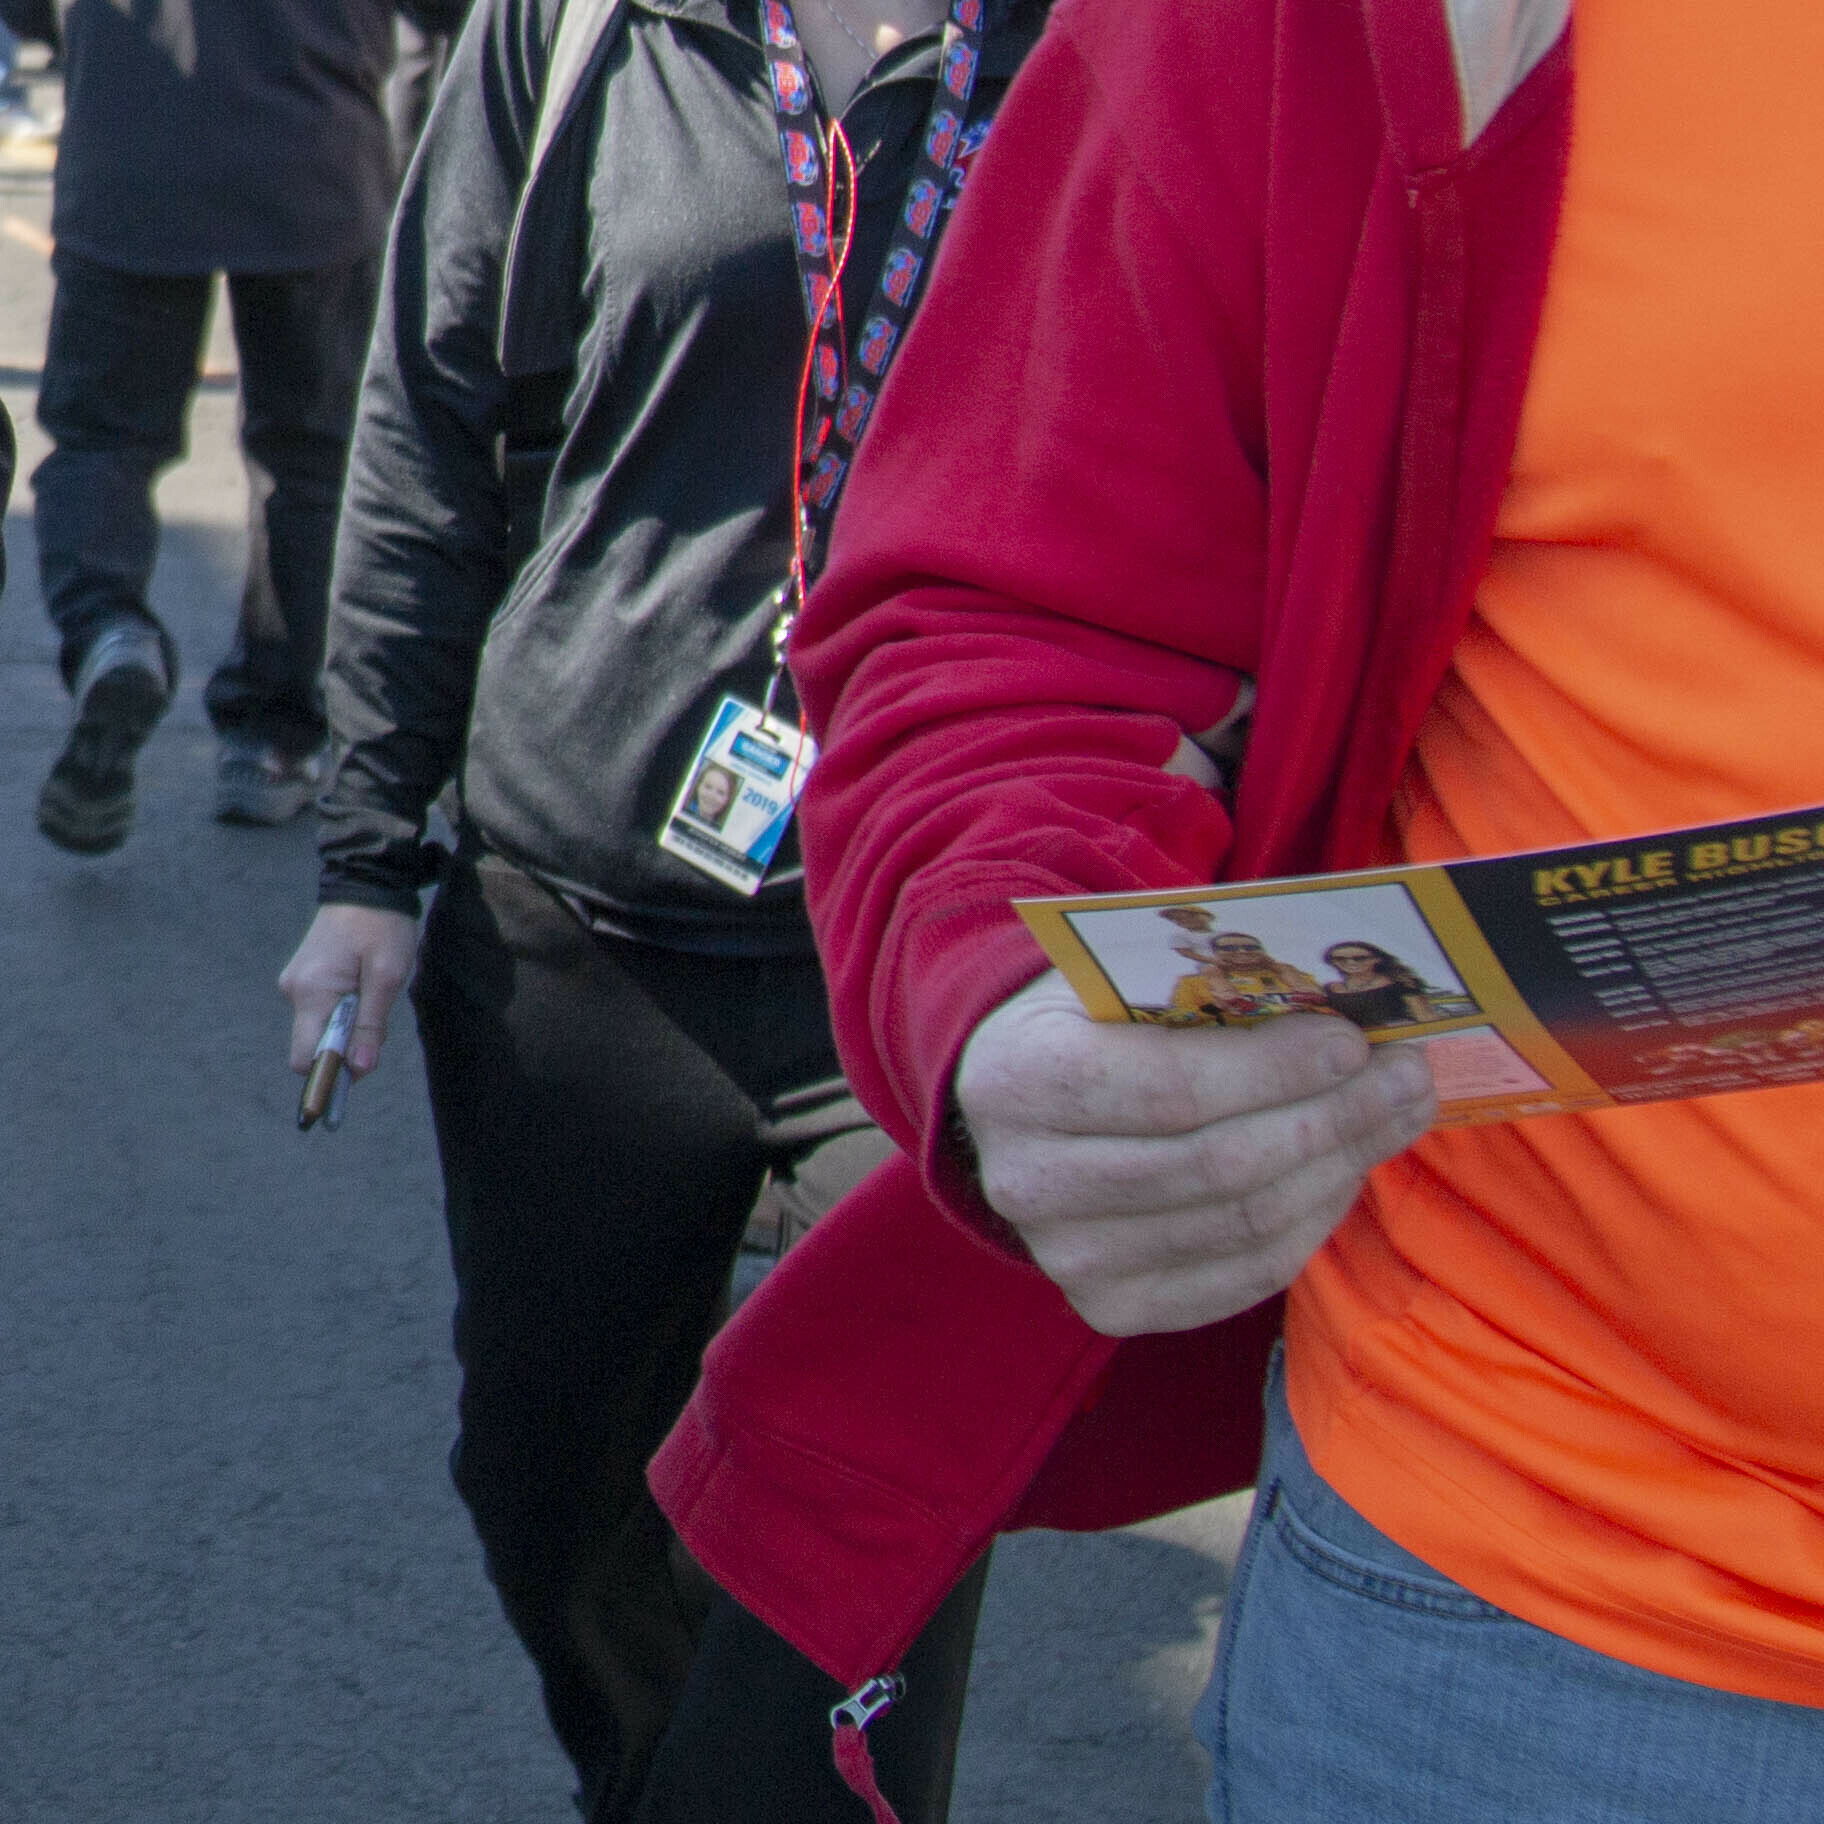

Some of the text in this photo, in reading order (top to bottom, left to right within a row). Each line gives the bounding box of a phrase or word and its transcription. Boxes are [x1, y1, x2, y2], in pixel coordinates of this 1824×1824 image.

[740, 786, 780, 818] 2019
[1532, 821, 1824, 897] KYLE BUS
